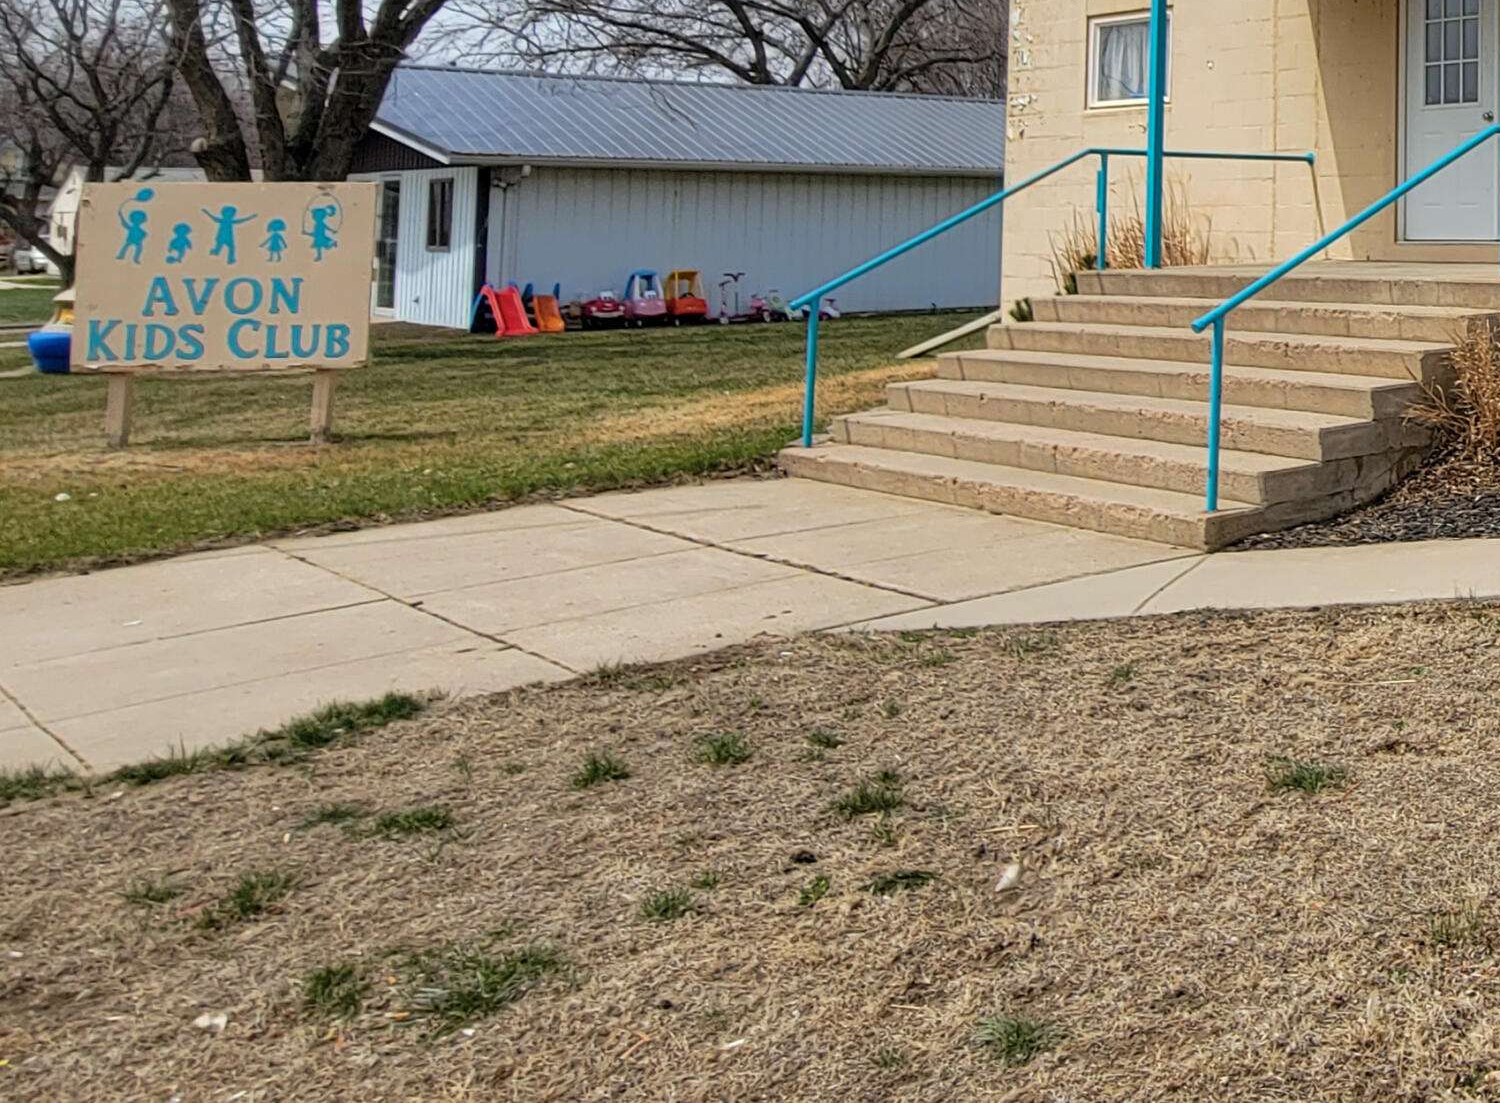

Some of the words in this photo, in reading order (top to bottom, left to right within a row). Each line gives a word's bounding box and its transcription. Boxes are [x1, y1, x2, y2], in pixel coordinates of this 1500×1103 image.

[141, 274, 304, 316] AVON
[86, 319, 205, 362] KIDS
[226, 318, 351, 360] CLUB
